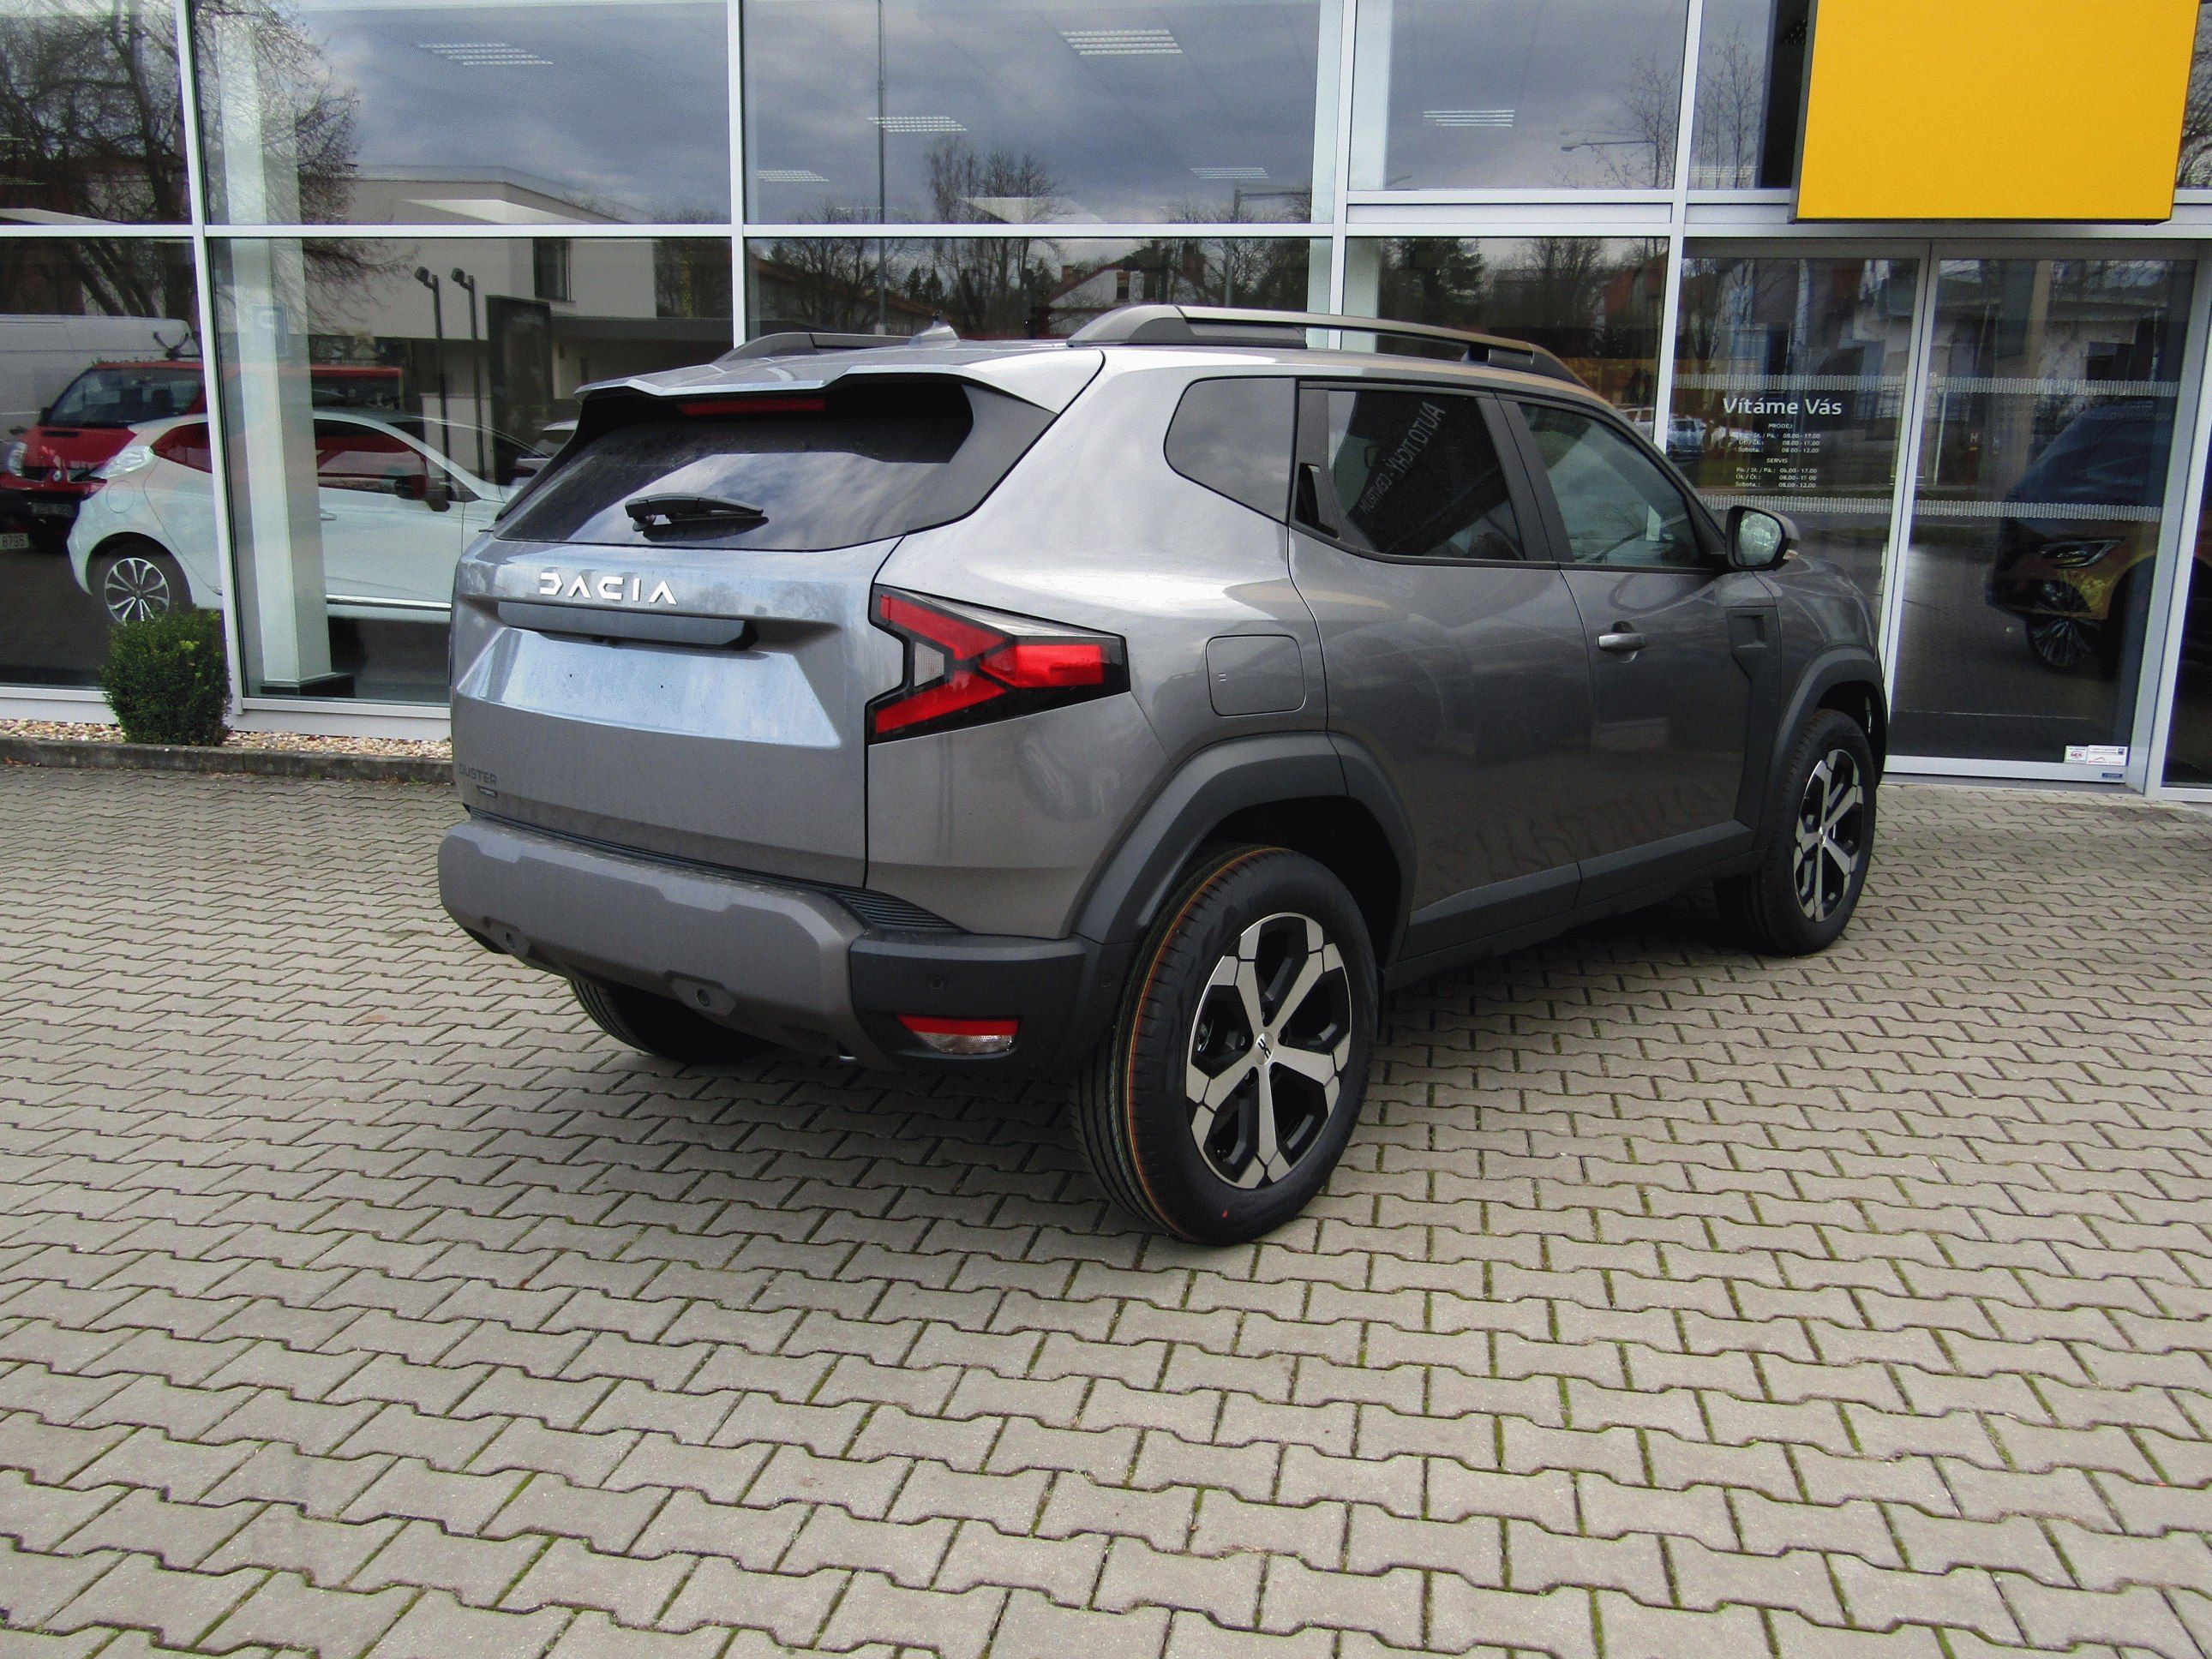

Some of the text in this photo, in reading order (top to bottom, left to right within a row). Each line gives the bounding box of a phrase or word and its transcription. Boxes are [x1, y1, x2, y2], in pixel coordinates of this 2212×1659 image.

[1723, 397, 1843, 416] Vítáme Vás
[539, 572, 677, 606] DACIA
